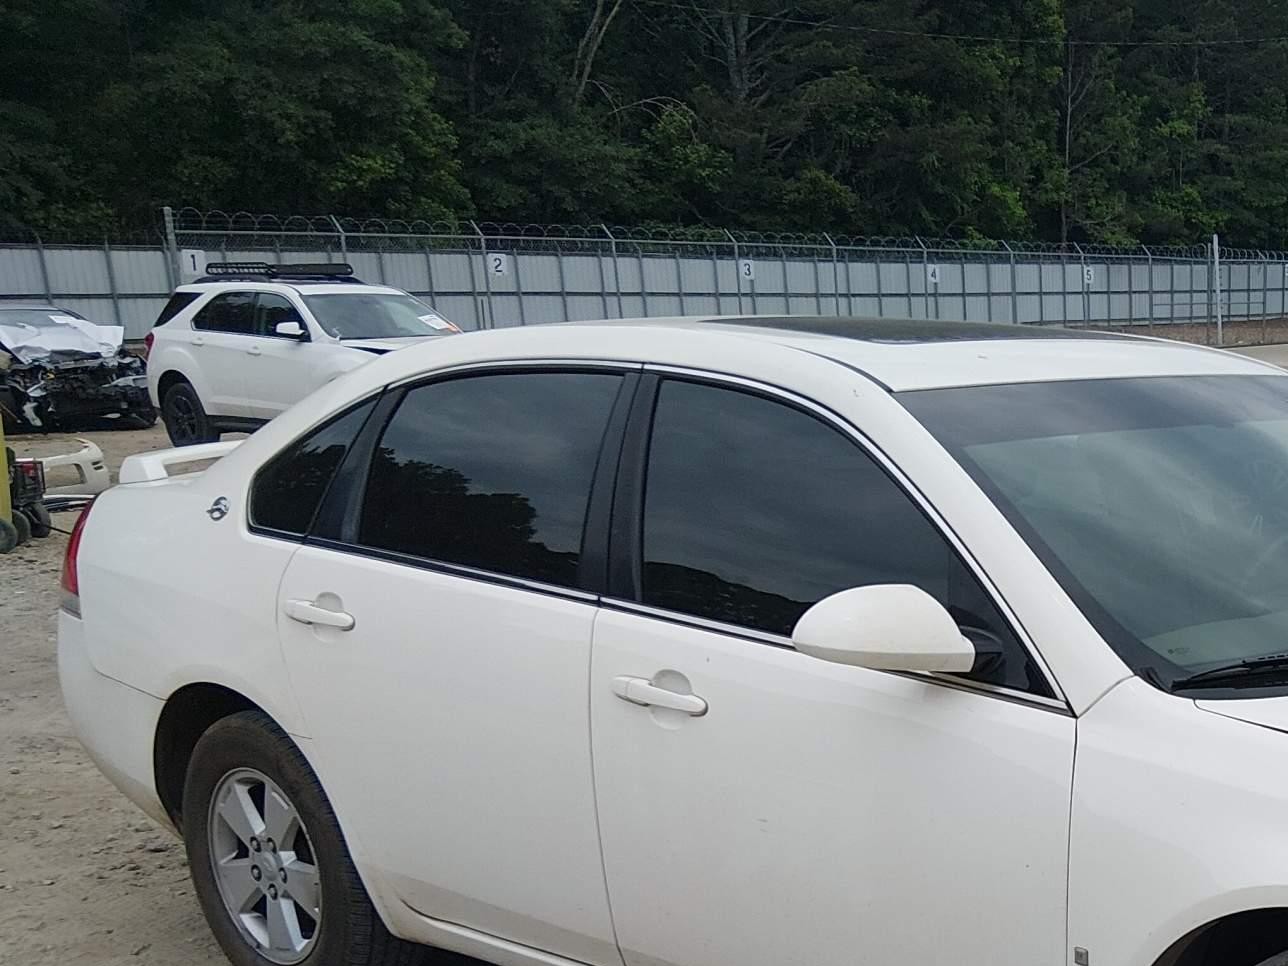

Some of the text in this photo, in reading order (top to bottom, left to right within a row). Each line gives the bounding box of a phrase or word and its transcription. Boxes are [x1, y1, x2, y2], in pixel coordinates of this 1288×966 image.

[190, 254, 197, 272] 1
[493, 257, 503, 273] 2
[743, 262, 752, 276] 3
[930, 266, 937, 280] 4
[1086, 269, 1092, 281] 5
